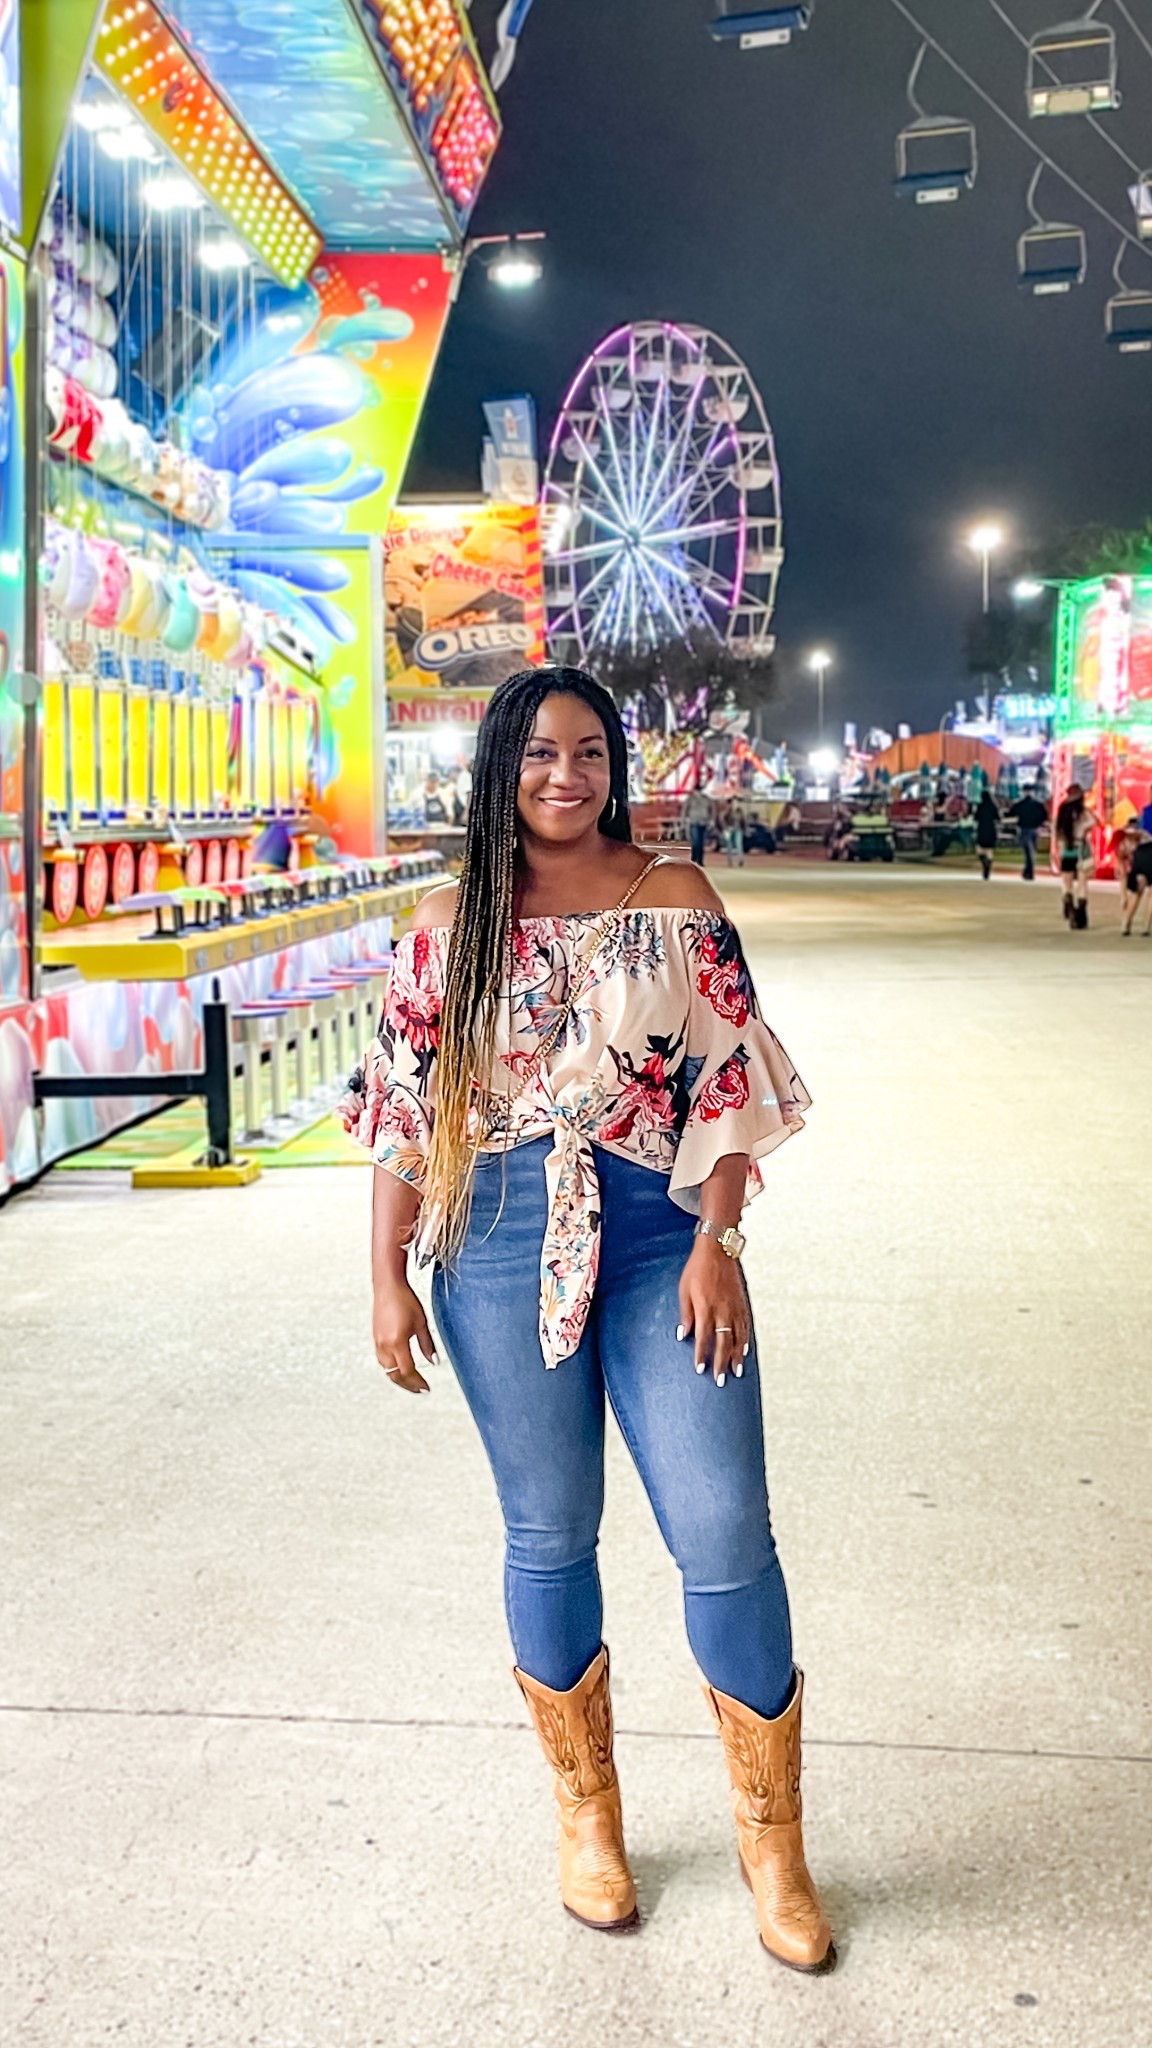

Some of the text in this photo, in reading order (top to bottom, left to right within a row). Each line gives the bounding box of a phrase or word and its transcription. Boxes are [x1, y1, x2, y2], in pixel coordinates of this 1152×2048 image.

[432, 553, 533, 600] Cheese Cake
[417, 623, 534, 664] OREO
